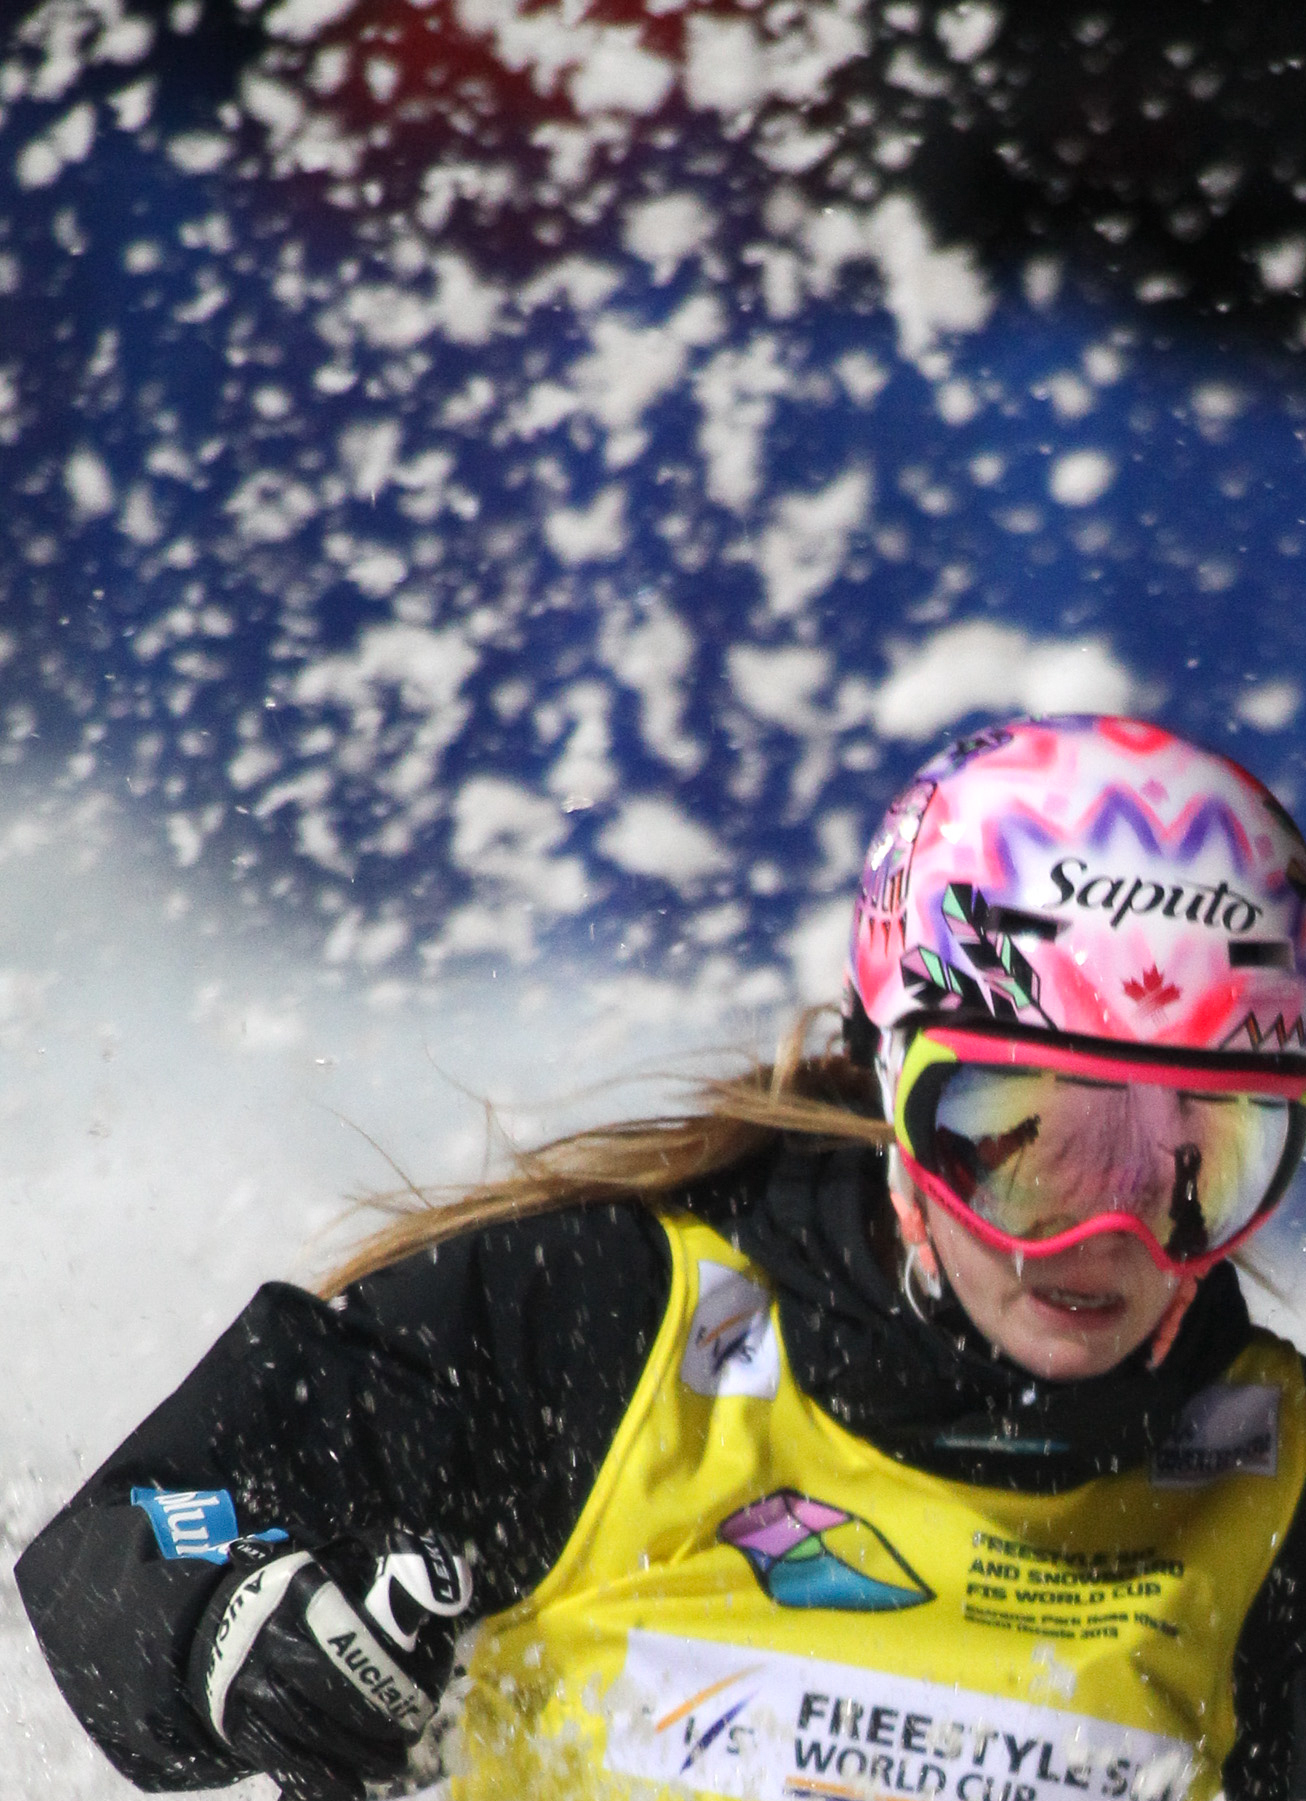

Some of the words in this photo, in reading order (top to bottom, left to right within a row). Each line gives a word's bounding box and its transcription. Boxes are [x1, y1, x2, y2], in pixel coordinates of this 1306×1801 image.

[1048, 858, 1263, 933] Saputo
[966, 1582, 1007, 1600] FIS
[1015, 1588, 1105, 1606] WORLD
[1112, 1581, 1161, 1599] CUP
[969, 1557, 1020, 1581] AND
[328, 1631, 421, 1725] Auclair
[794, 1737, 946, 1796] WORLD
